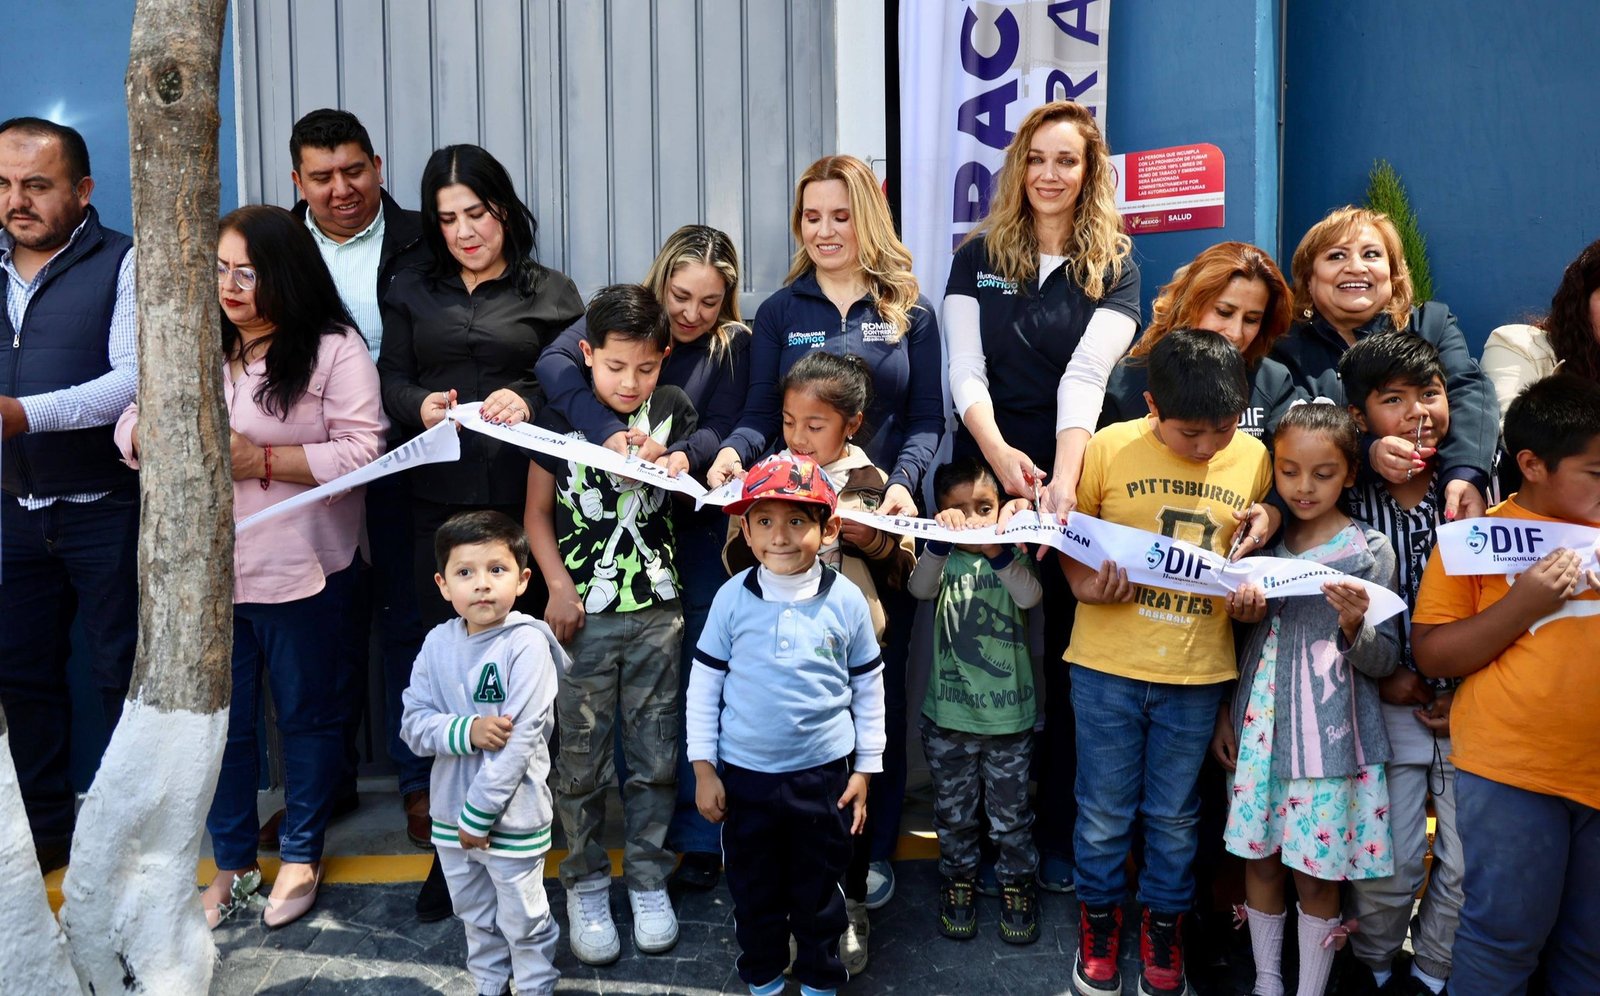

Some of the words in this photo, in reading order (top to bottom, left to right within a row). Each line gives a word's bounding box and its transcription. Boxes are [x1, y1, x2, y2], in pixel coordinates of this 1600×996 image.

[1168, 213, 1192, 222] SALUD
[1126, 478, 1246, 512] PITTSBURGH
[1490, 526, 1544, 554] DIF
[1164, 546, 1212, 580] DIF
[1493, 554, 1544, 563] HUIXQUILUCA
[1134, 586, 1213, 615] IRATES
[473, 662, 506, 702] A
